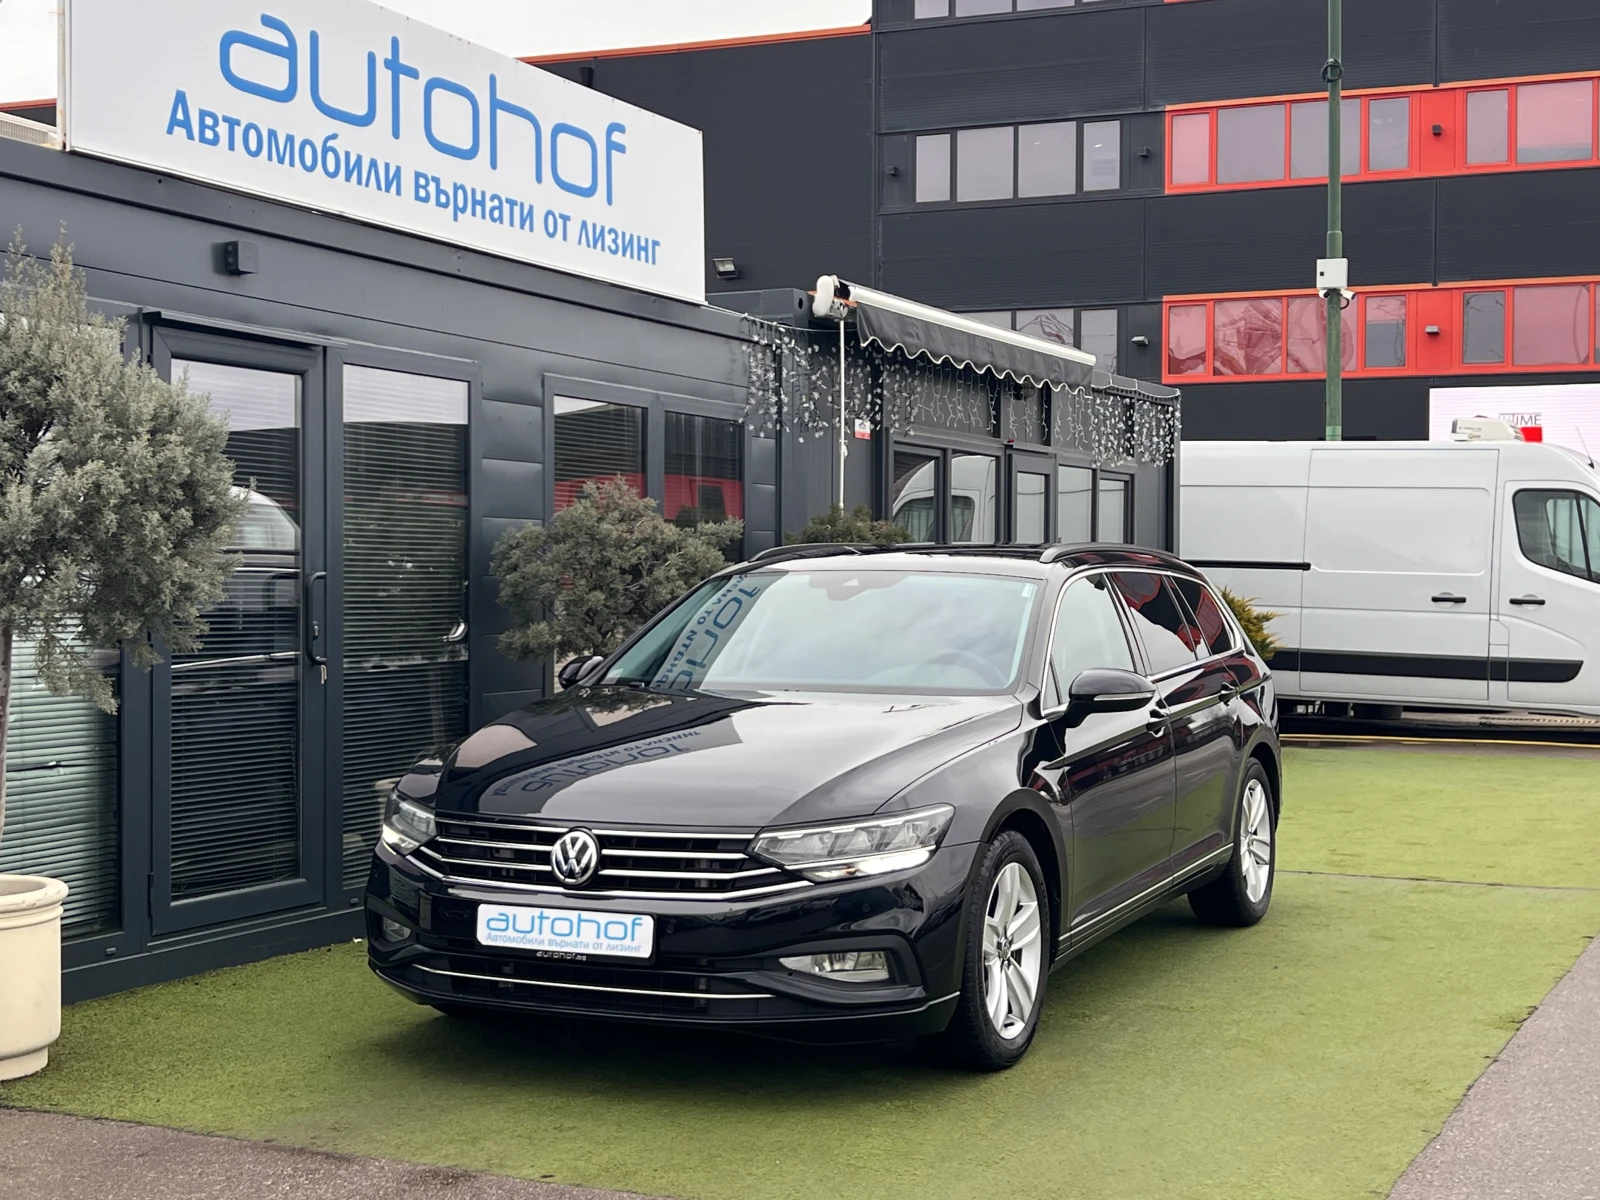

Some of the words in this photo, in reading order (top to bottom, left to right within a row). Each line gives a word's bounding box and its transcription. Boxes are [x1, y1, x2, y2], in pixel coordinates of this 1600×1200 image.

[219, 13, 626, 206] autohof
[166, 89, 402, 197] Автомобили
[414, 170, 535, 233] върнати
[543, 209, 571, 242] от
[577, 220, 661, 266] лизинг
[486, 911, 643, 942] autohof
[486, 931, 545, 946] Автомобили
[548, 938, 590, 950] върнати
[592, 941, 604, 951] от
[606, 942, 642, 953] лизинг
